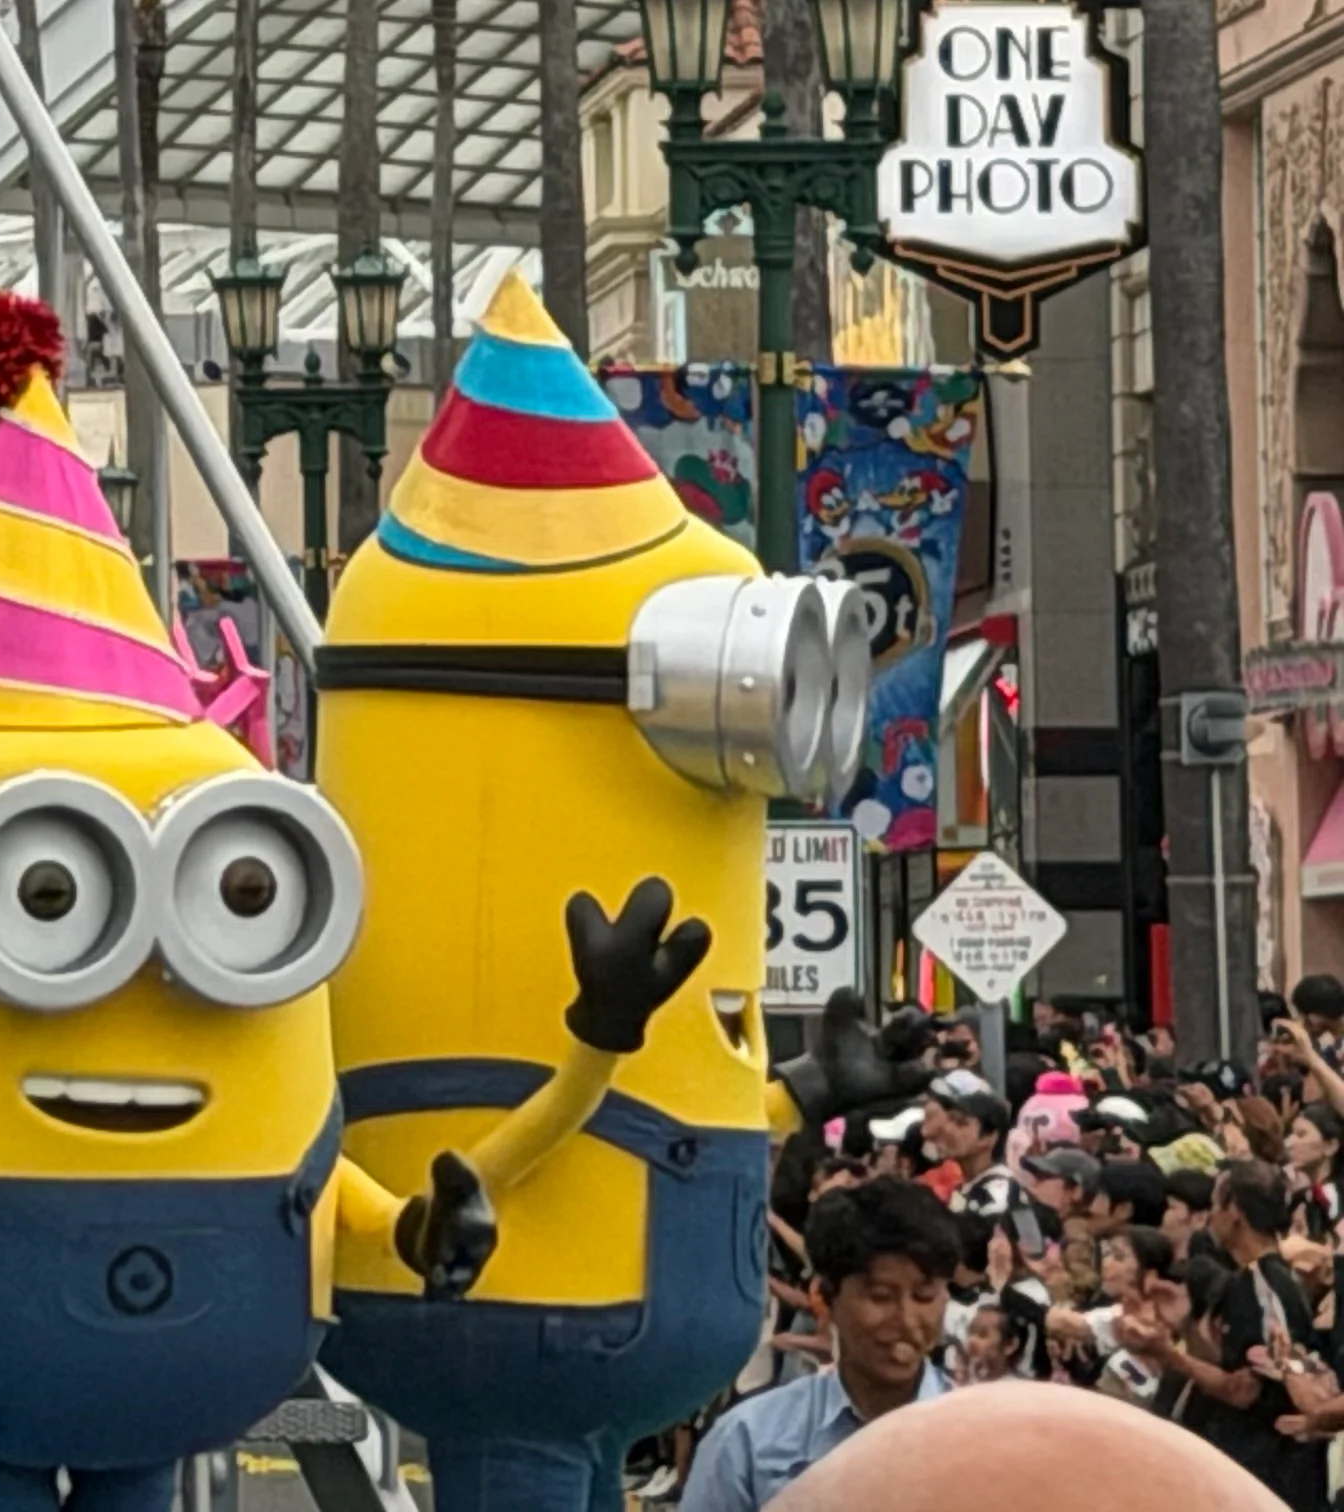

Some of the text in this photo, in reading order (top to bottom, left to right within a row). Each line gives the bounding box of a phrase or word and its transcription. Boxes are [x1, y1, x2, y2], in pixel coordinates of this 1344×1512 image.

[938, 25, 1071, 82] ONE
[946, 94, 1065, 148] DAY
[900, 158, 1114, 214] PHOTO
[793, 836, 849, 864] LIMIT
